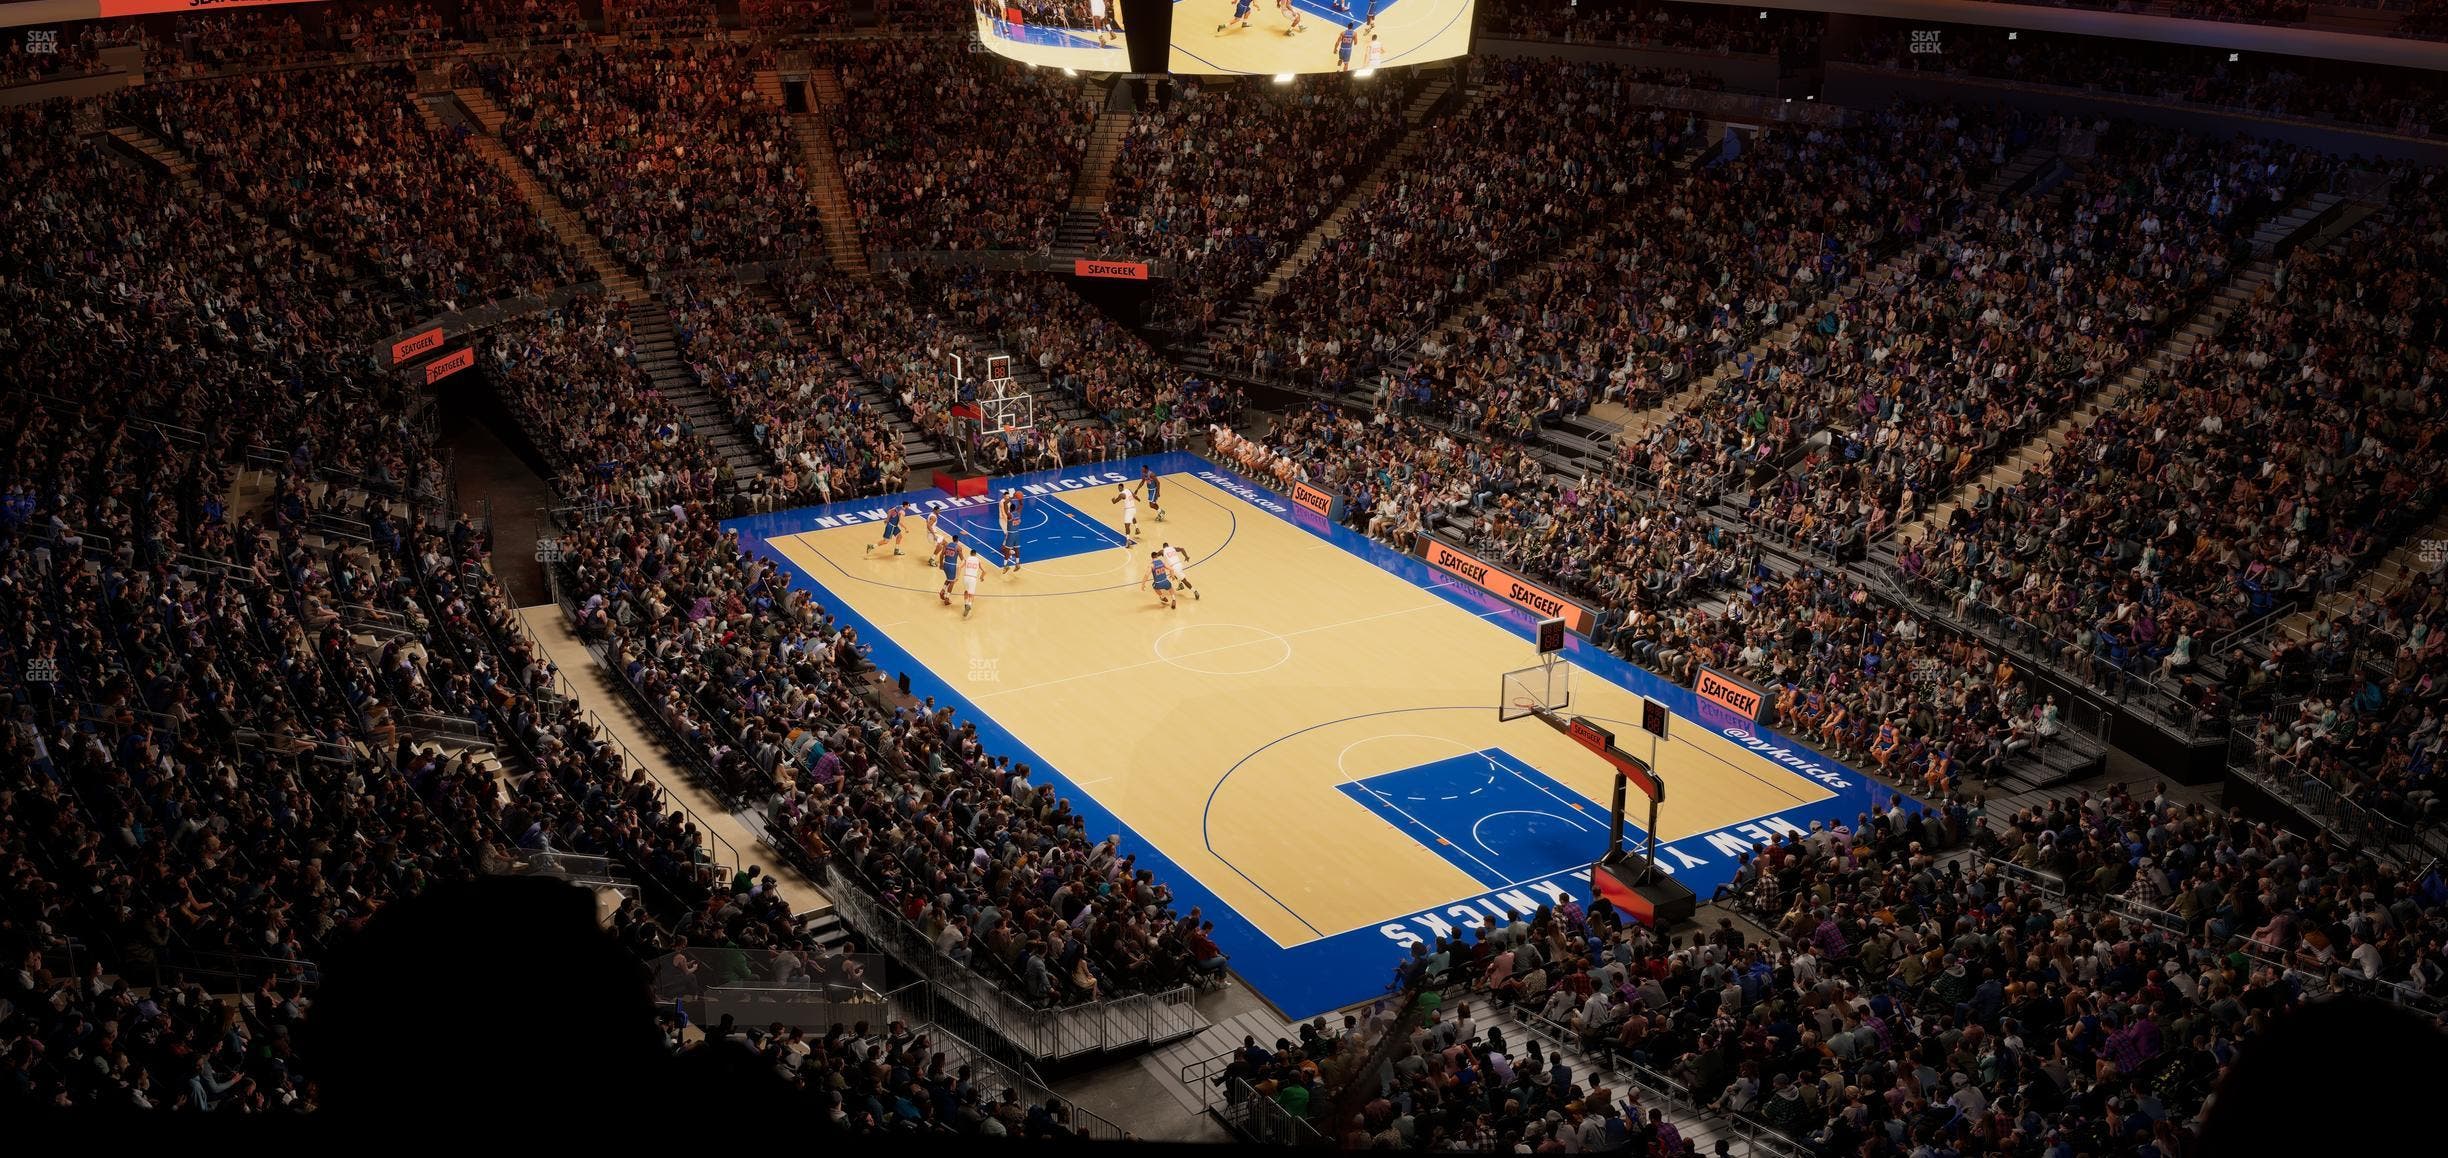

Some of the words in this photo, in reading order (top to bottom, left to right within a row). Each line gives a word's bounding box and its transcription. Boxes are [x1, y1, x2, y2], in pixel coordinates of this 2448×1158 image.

[1088, 264, 1136, 277] SEATGEEK
[400, 335, 434, 358] SEATGEEK
[433, 355, 465, 377] SEATGEEK
[1197, 471, 1287, 513] nyknicks.com
[1295, 486, 1329, 513] SEATGEEK
[814, 508, 888, 528] NEW
[1438, 550, 1488, 585] SEATGEEK
[1509, 583, 1564, 618] SEATGEEK
[1701, 677, 1756, 716] SEATGEEK
[1574, 724, 1601, 746] SEATGEEK
[1723, 728, 1852, 789] @nyknicks
[1703, 816, 1809, 857] NEW
[1380, 880, 1578, 949] KNICKS
